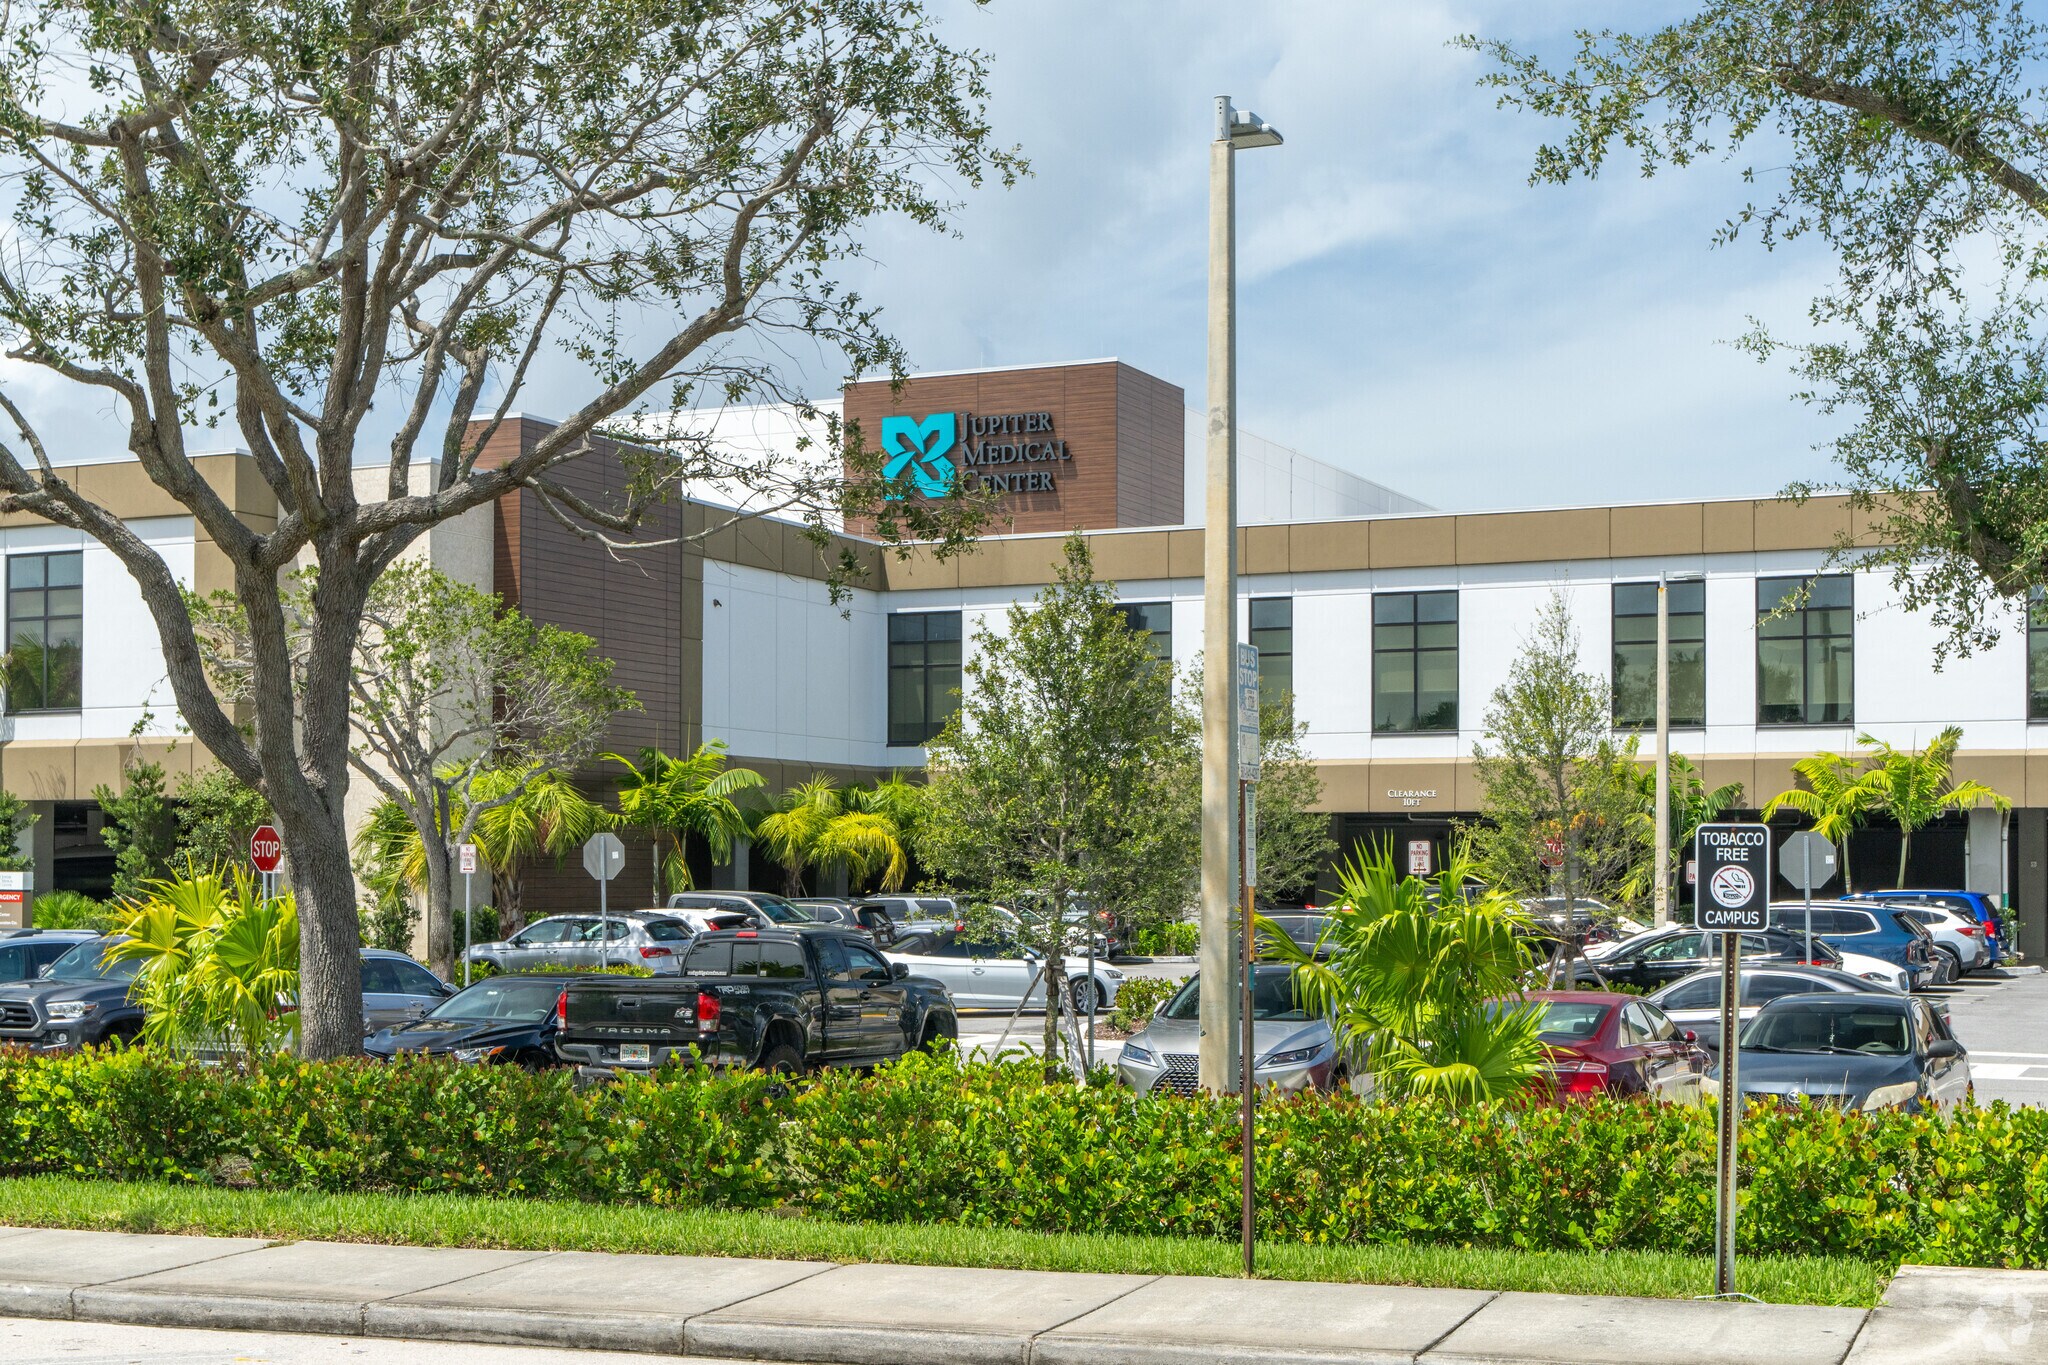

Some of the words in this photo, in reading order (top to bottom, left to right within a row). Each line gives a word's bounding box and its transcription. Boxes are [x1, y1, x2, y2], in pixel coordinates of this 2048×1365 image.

[960, 412, 1053, 442] JUPITER
[960, 440, 1072, 467] MEDICAL
[962, 470, 1055, 495] CENTER
[1240, 647, 1256, 668] BUS
[1240, 667, 1257, 688] STOP
[1387, 789, 1437, 798] CLEARANCE
[1403, 798, 1421, 806] 10FT
[1701, 832, 1764, 846] TOBACCO
[253, 840, 280, 857] STOP
[1716, 847, 1749, 861] FREE
[1705, 910, 1760, 925] CAMPUS
